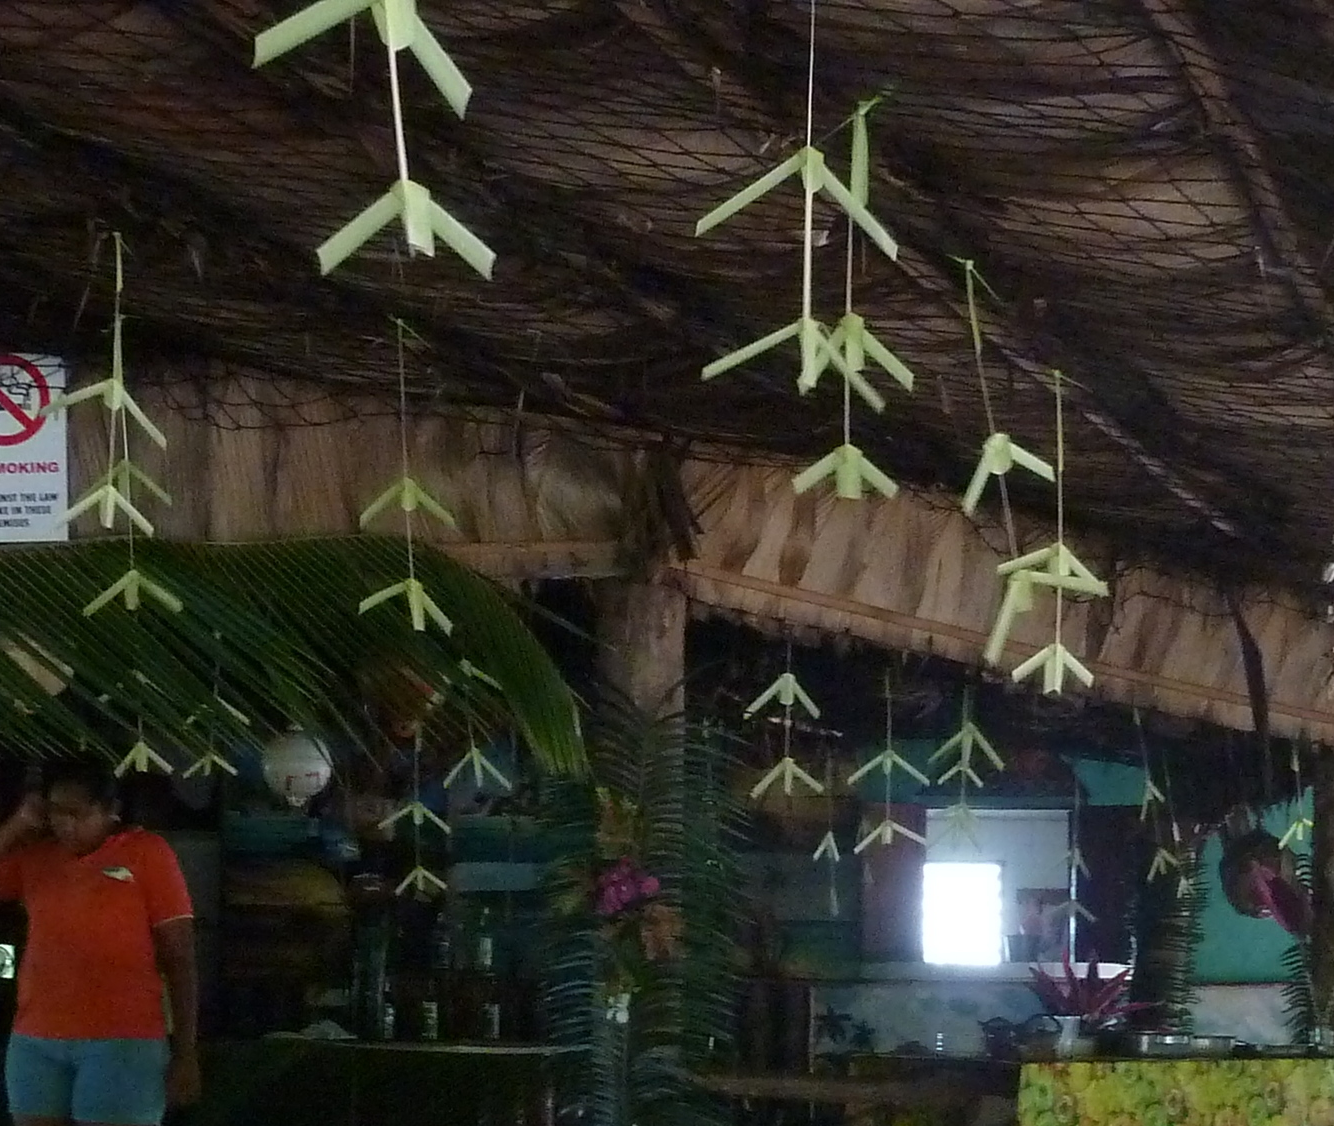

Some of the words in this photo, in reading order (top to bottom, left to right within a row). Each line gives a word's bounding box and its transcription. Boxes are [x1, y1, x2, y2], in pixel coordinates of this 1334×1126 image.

[20, 493, 36, 502] THE
[39, 493, 58, 502] LAW
[11, 506, 22, 515] IN
